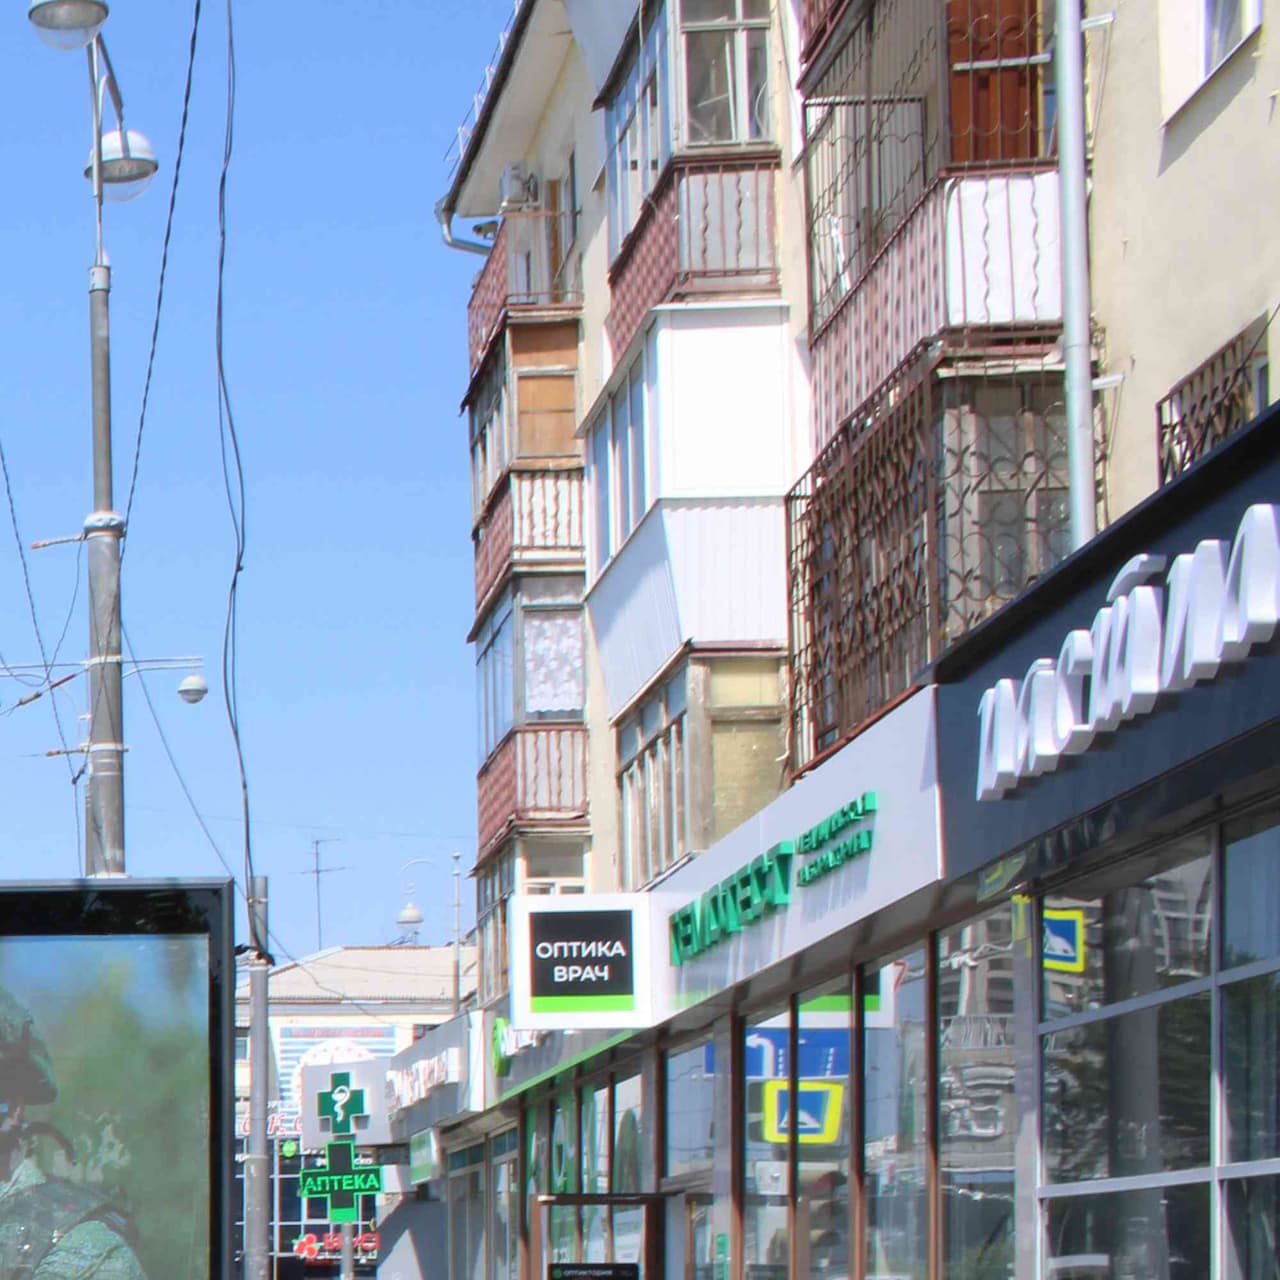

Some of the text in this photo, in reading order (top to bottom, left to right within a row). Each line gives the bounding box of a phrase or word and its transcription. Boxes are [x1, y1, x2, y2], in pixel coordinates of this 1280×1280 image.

[535, 940, 627, 959] ОПТИКА
[553, 965, 610, 983] ВРАЧ
[303, 1173, 380, 1193] АПТЕКА
